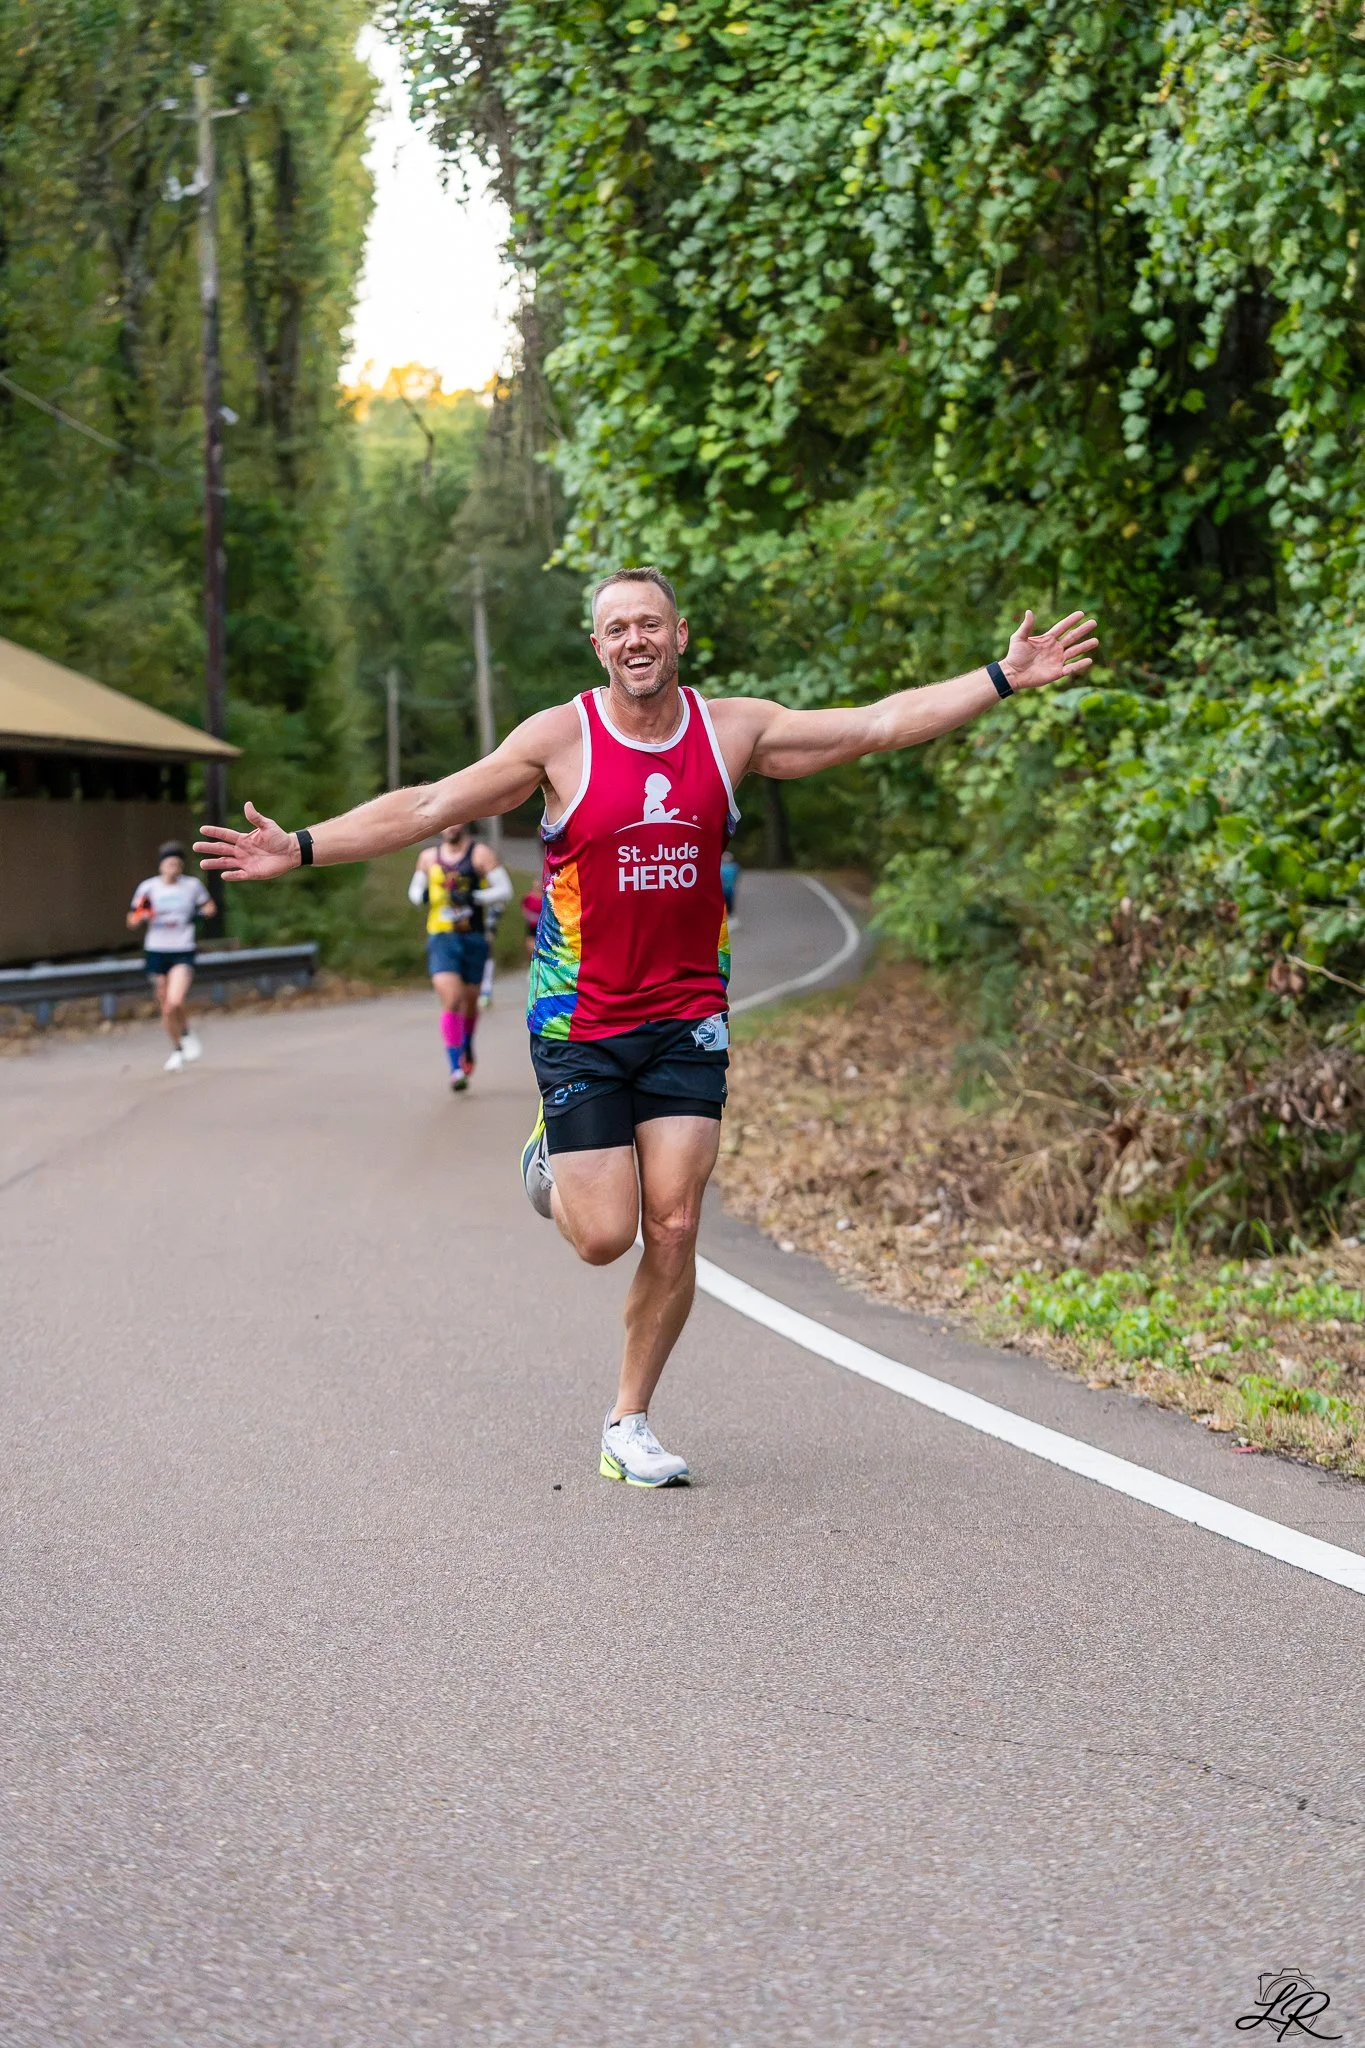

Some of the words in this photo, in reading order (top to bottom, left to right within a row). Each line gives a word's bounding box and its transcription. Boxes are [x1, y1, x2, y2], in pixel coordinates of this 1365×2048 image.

[617, 845, 647, 863] St.
[650, 842, 699, 861] Jude
[618, 863, 698, 892] HERO
